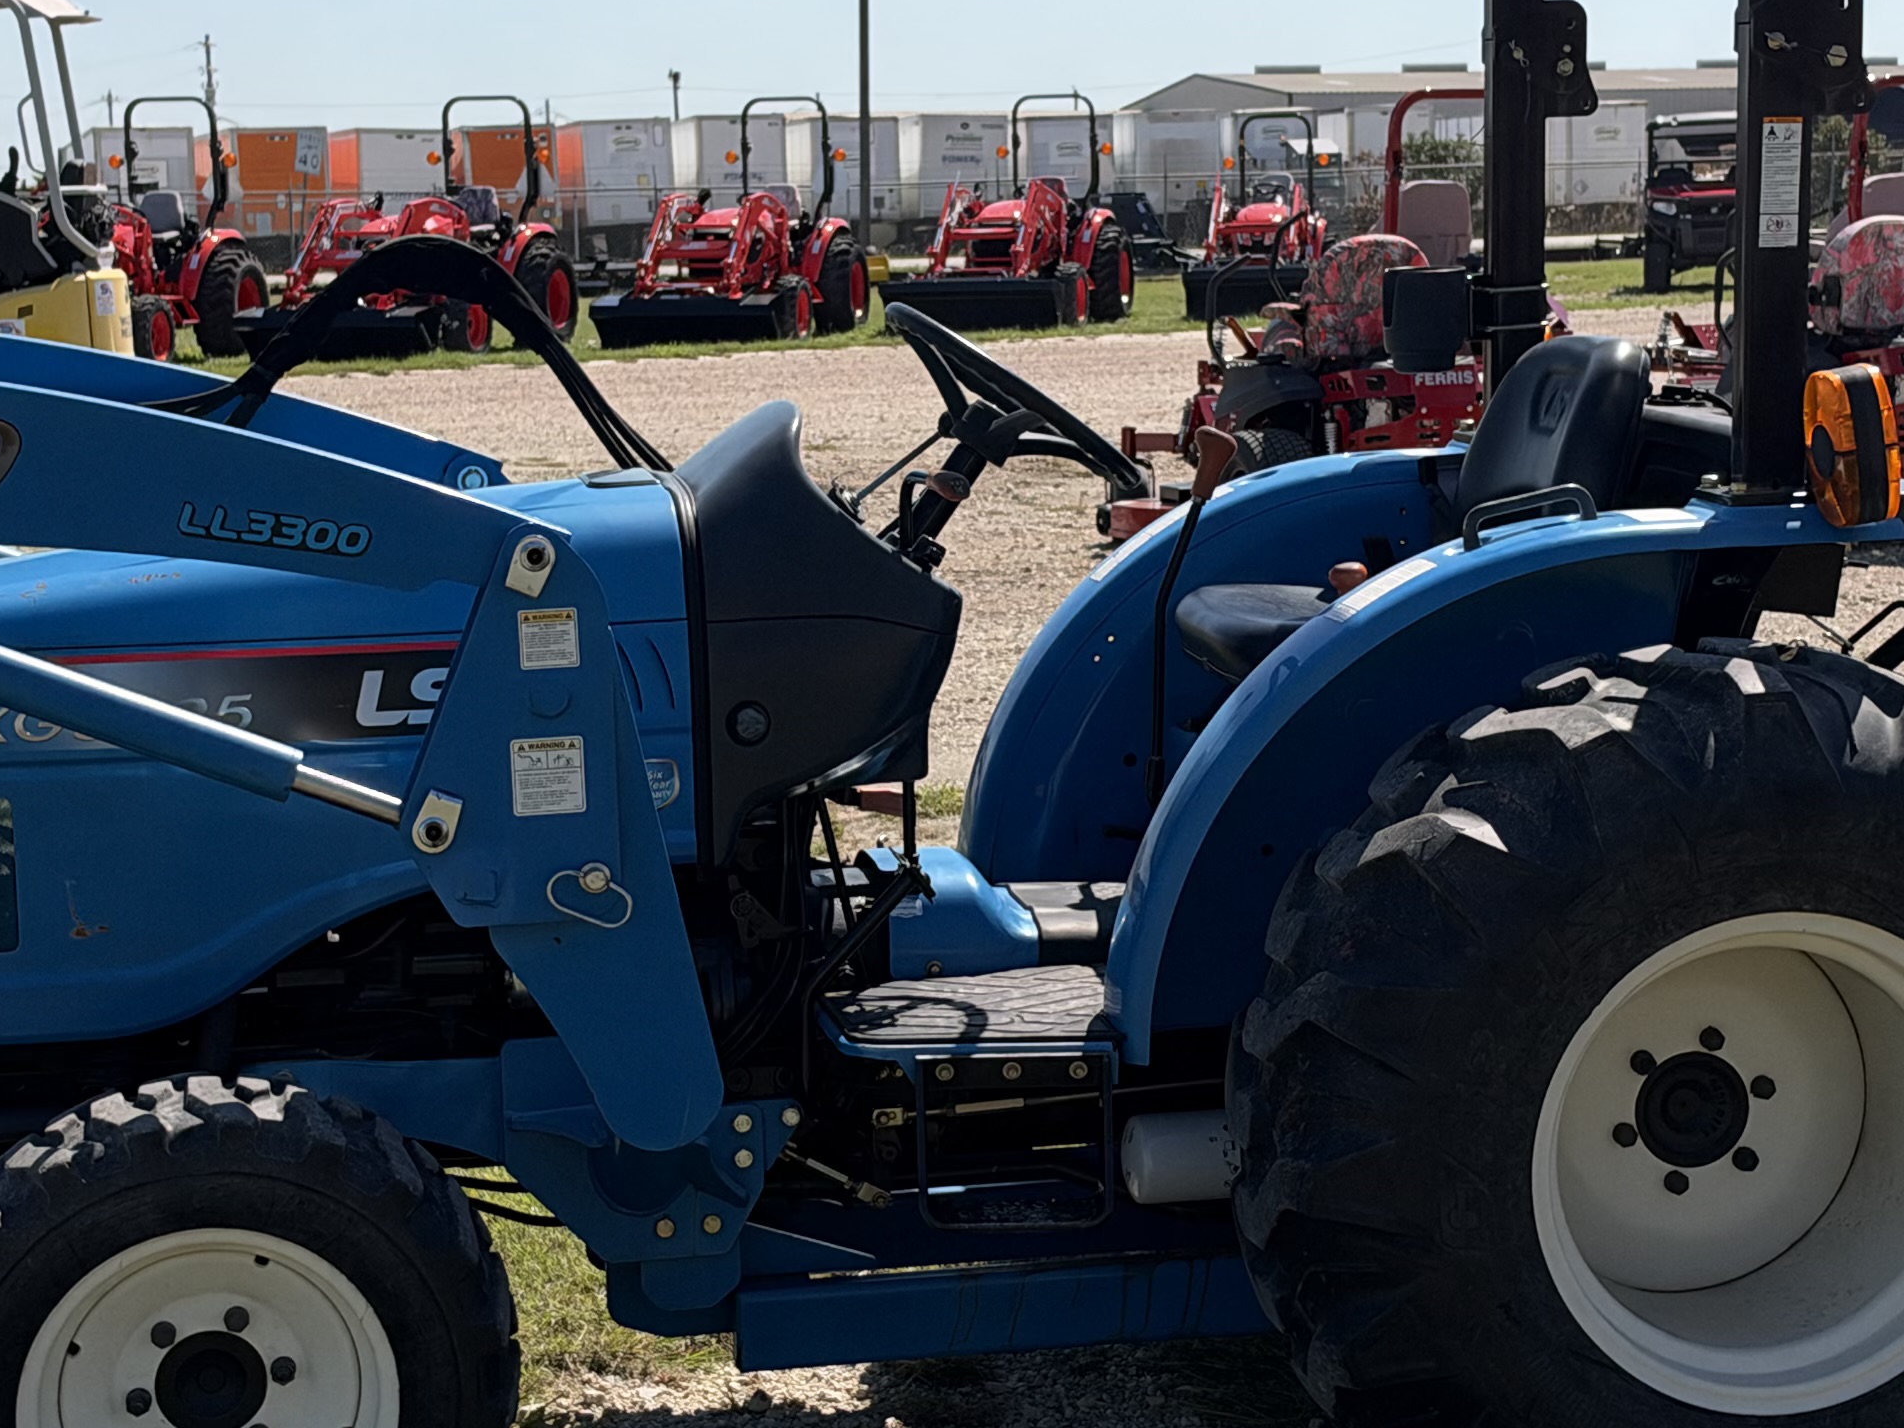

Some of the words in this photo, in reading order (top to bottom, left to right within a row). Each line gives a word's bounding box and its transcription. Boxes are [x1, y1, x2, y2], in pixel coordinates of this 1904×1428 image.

[1415, 370, 1474, 387] FERRIS
[177, 501, 373, 557] LL3300
[527, 740, 566, 750] WARNING
